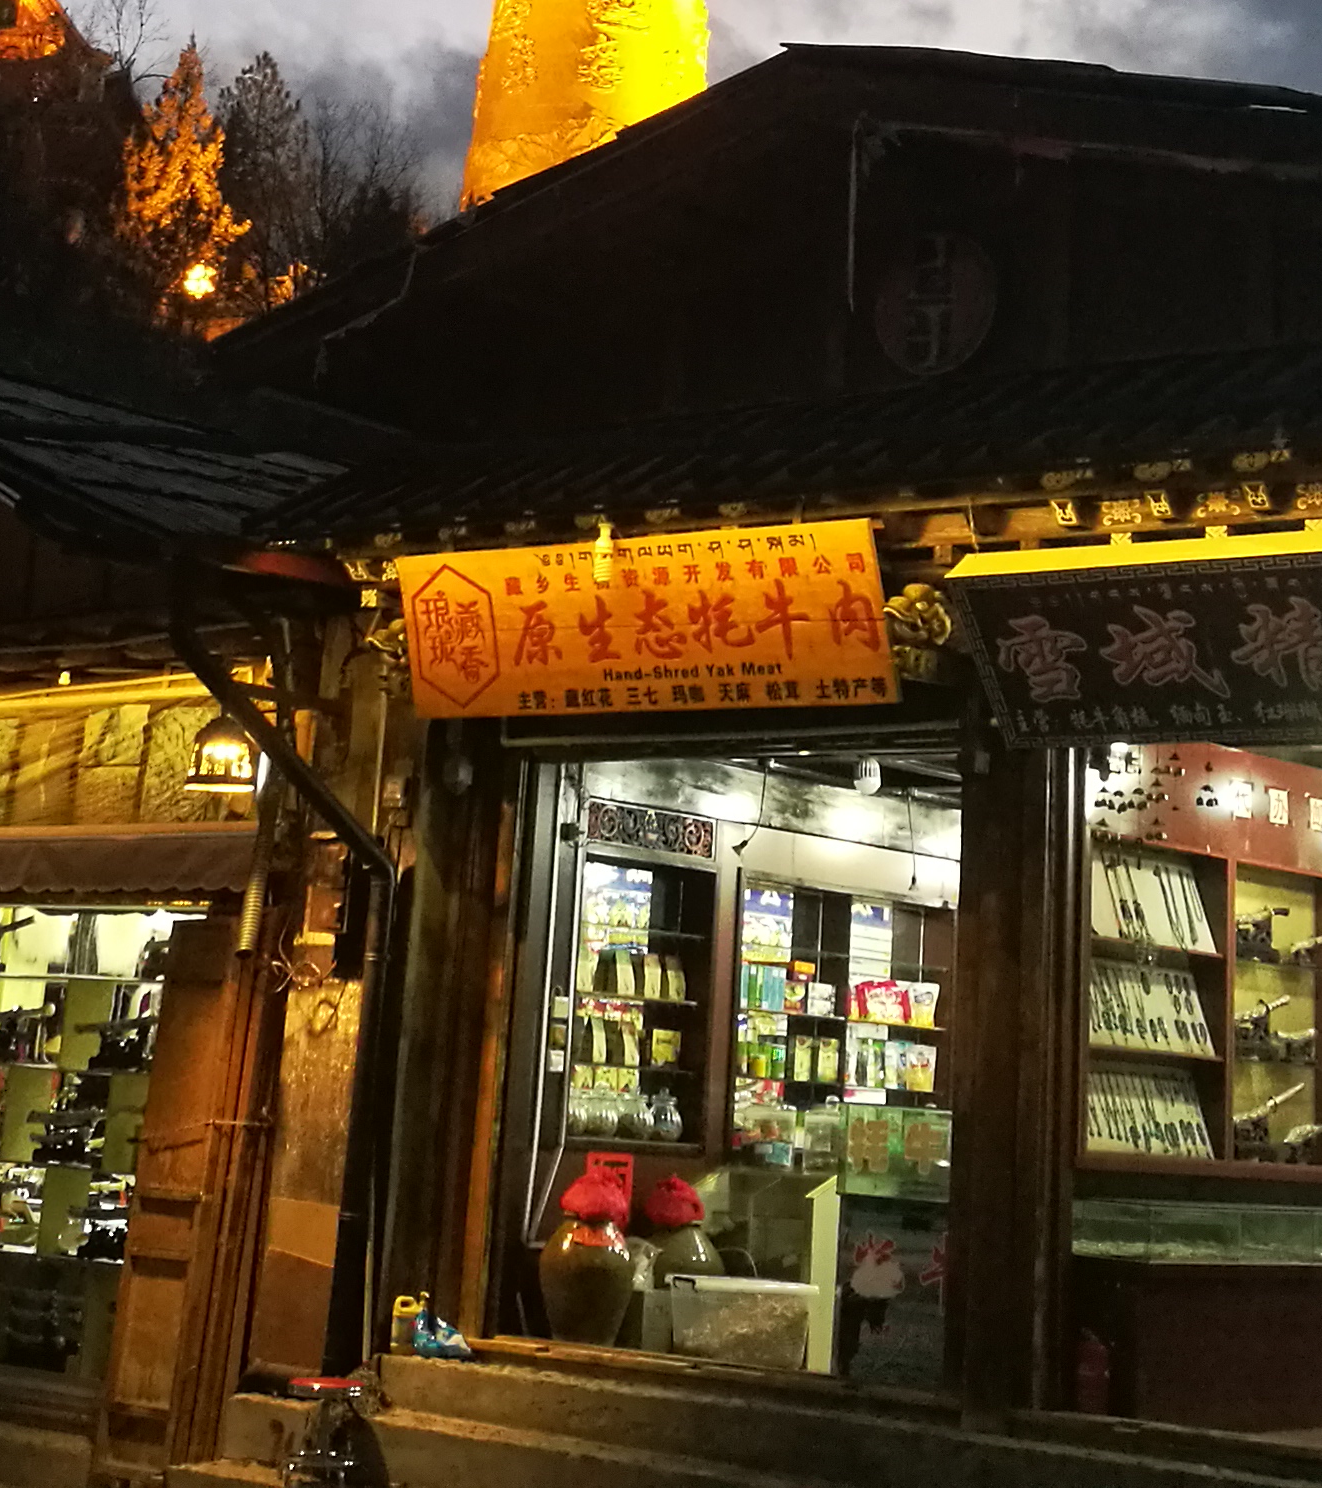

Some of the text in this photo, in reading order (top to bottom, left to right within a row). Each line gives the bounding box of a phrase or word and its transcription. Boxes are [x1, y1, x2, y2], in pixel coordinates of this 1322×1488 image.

[514, 578, 882, 666] 原生态牦牛肉
[603, 663, 783, 682] Hand-Shred Yak Meat
[626, 686, 659, 706] 三七
[718, 682, 752, 703] 天麻
[765, 680, 801, 701] 松茸
[815, 677, 887, 700] 土特产等
